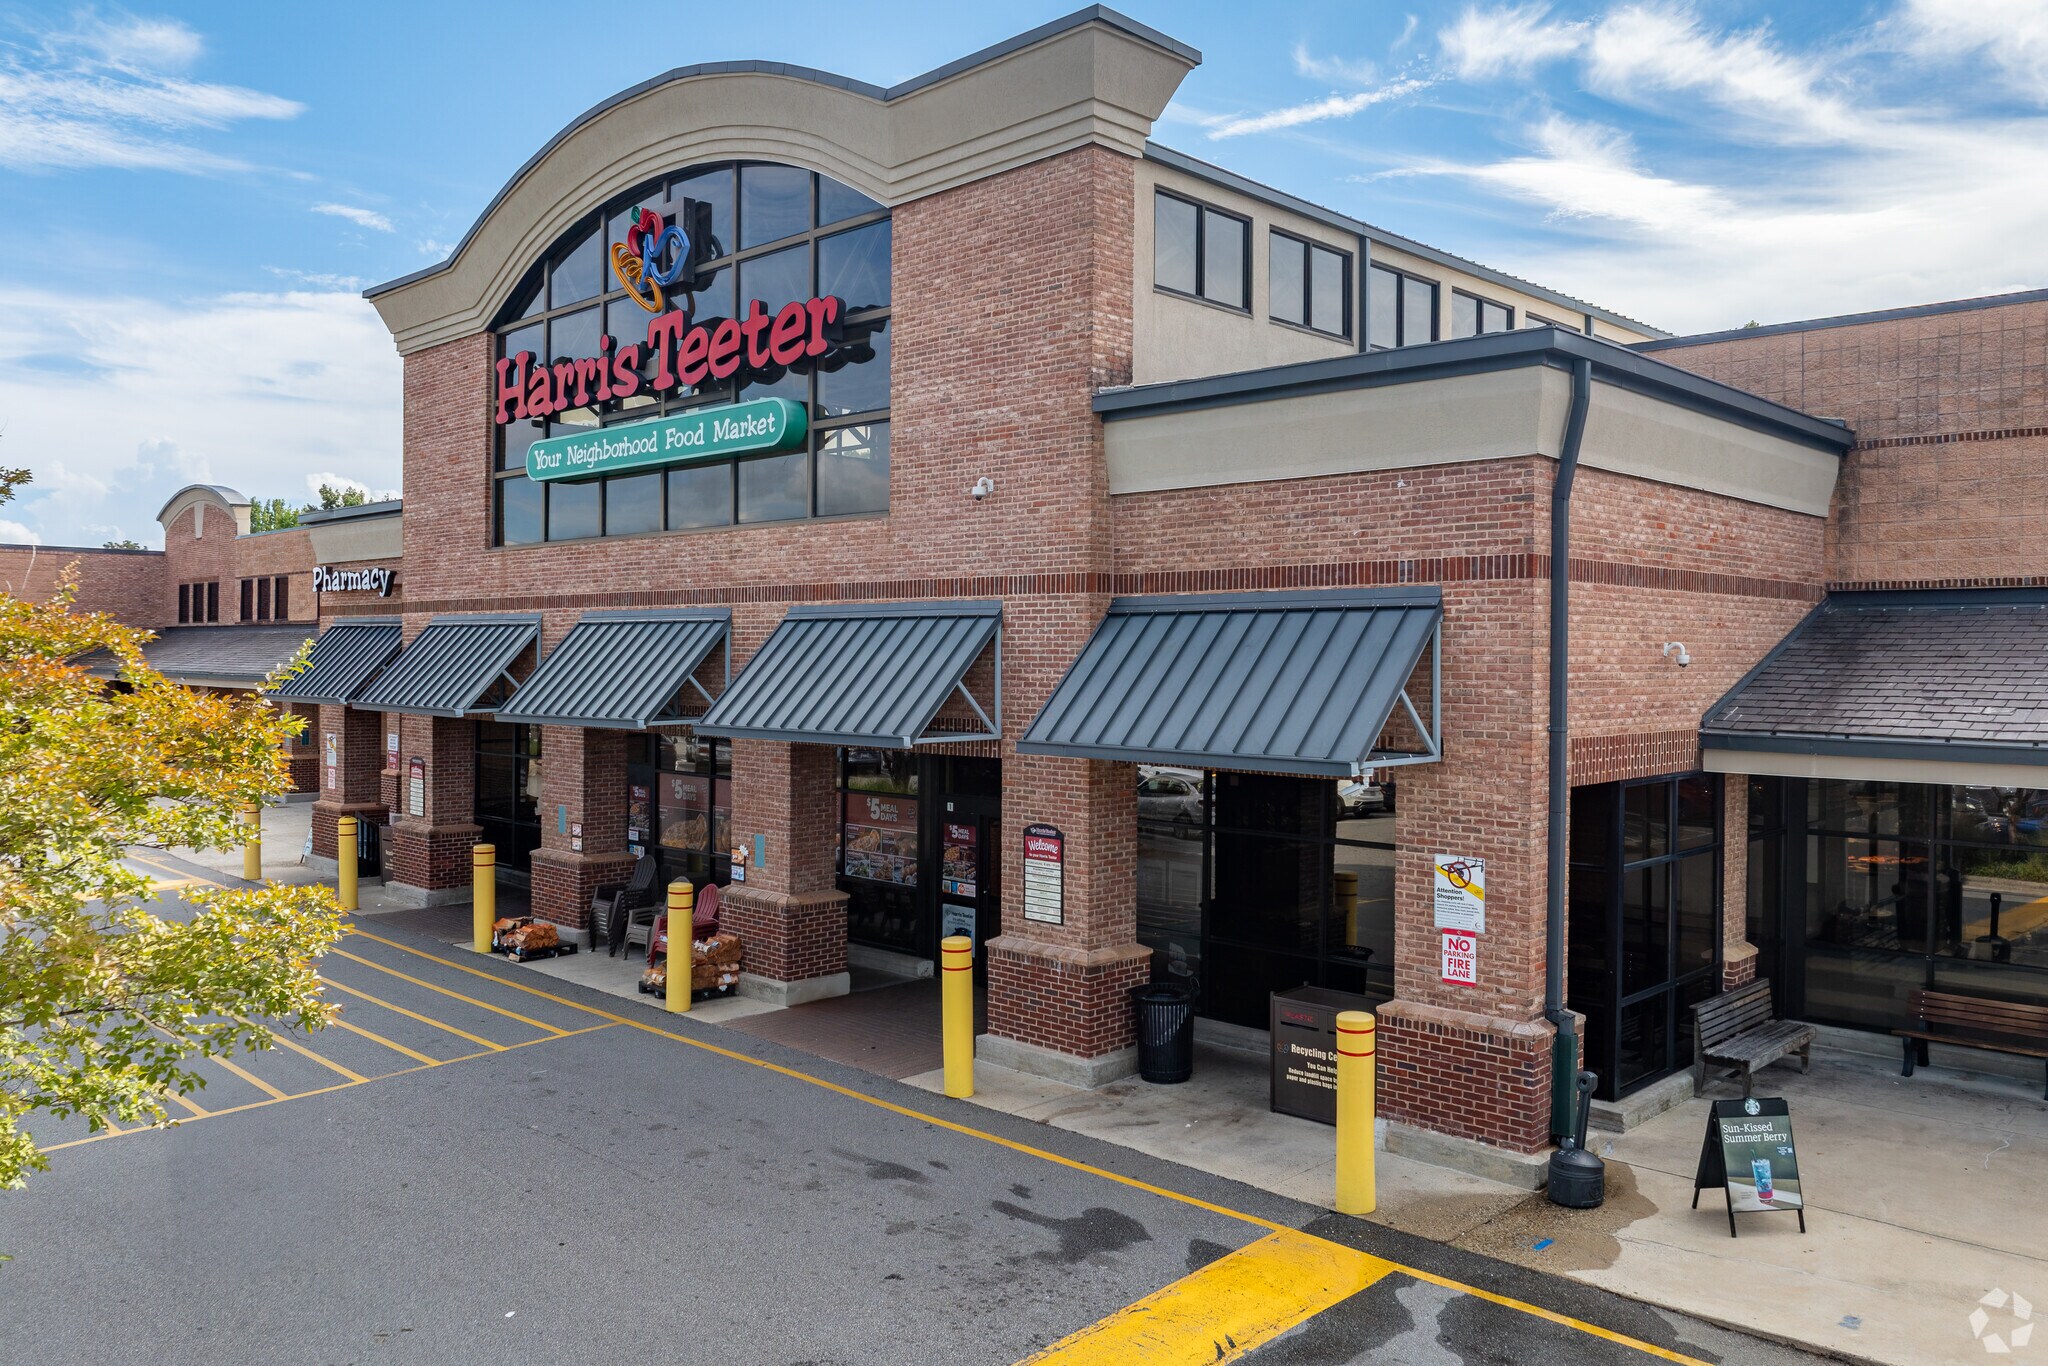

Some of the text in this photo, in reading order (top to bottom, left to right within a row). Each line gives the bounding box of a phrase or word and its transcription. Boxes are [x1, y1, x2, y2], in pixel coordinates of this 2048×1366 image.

[494, 294, 841, 425] Harris Teeter
[533, 411, 777, 470] Your Neighborhood Food Market
[312, 565, 391, 598] Pharmacy
[672, 779, 697, 800] $5 MEAL
[683, 792, 697, 801] DAYS
[866, 797, 880, 820] $5
[880, 803, 899, 814] MEAL
[880, 812, 898, 822] DAYS
[949, 824, 958, 839] $5
[1028, 838, 1058, 854] Welcome
[1436, 887, 1463, 895] Attention
[1436, 892, 1465, 901] Shoppers!
[1448, 937, 1471, 952] NO
[1443, 949, 1475, 960] PARKING
[1447, 958, 1471, 971] FIRE
[1447, 968, 1471, 979] LANE
[1291, 1043, 1337, 1062] Recycling Ce
[1288, 1067, 1304, 1076] Reduce
[1306, 1061, 1316, 1070] You
[1317, 1064, 1327, 1073] Can
[1299, 1076, 1307, 1084] and
[1307, 1079, 1322, 1087] plastic
[1322, 1082, 1333, 1090] bags
[1722, 1122, 1773, 1133] Sun-Kissed
[1724, 1132, 1788, 1144] Summer Berry
